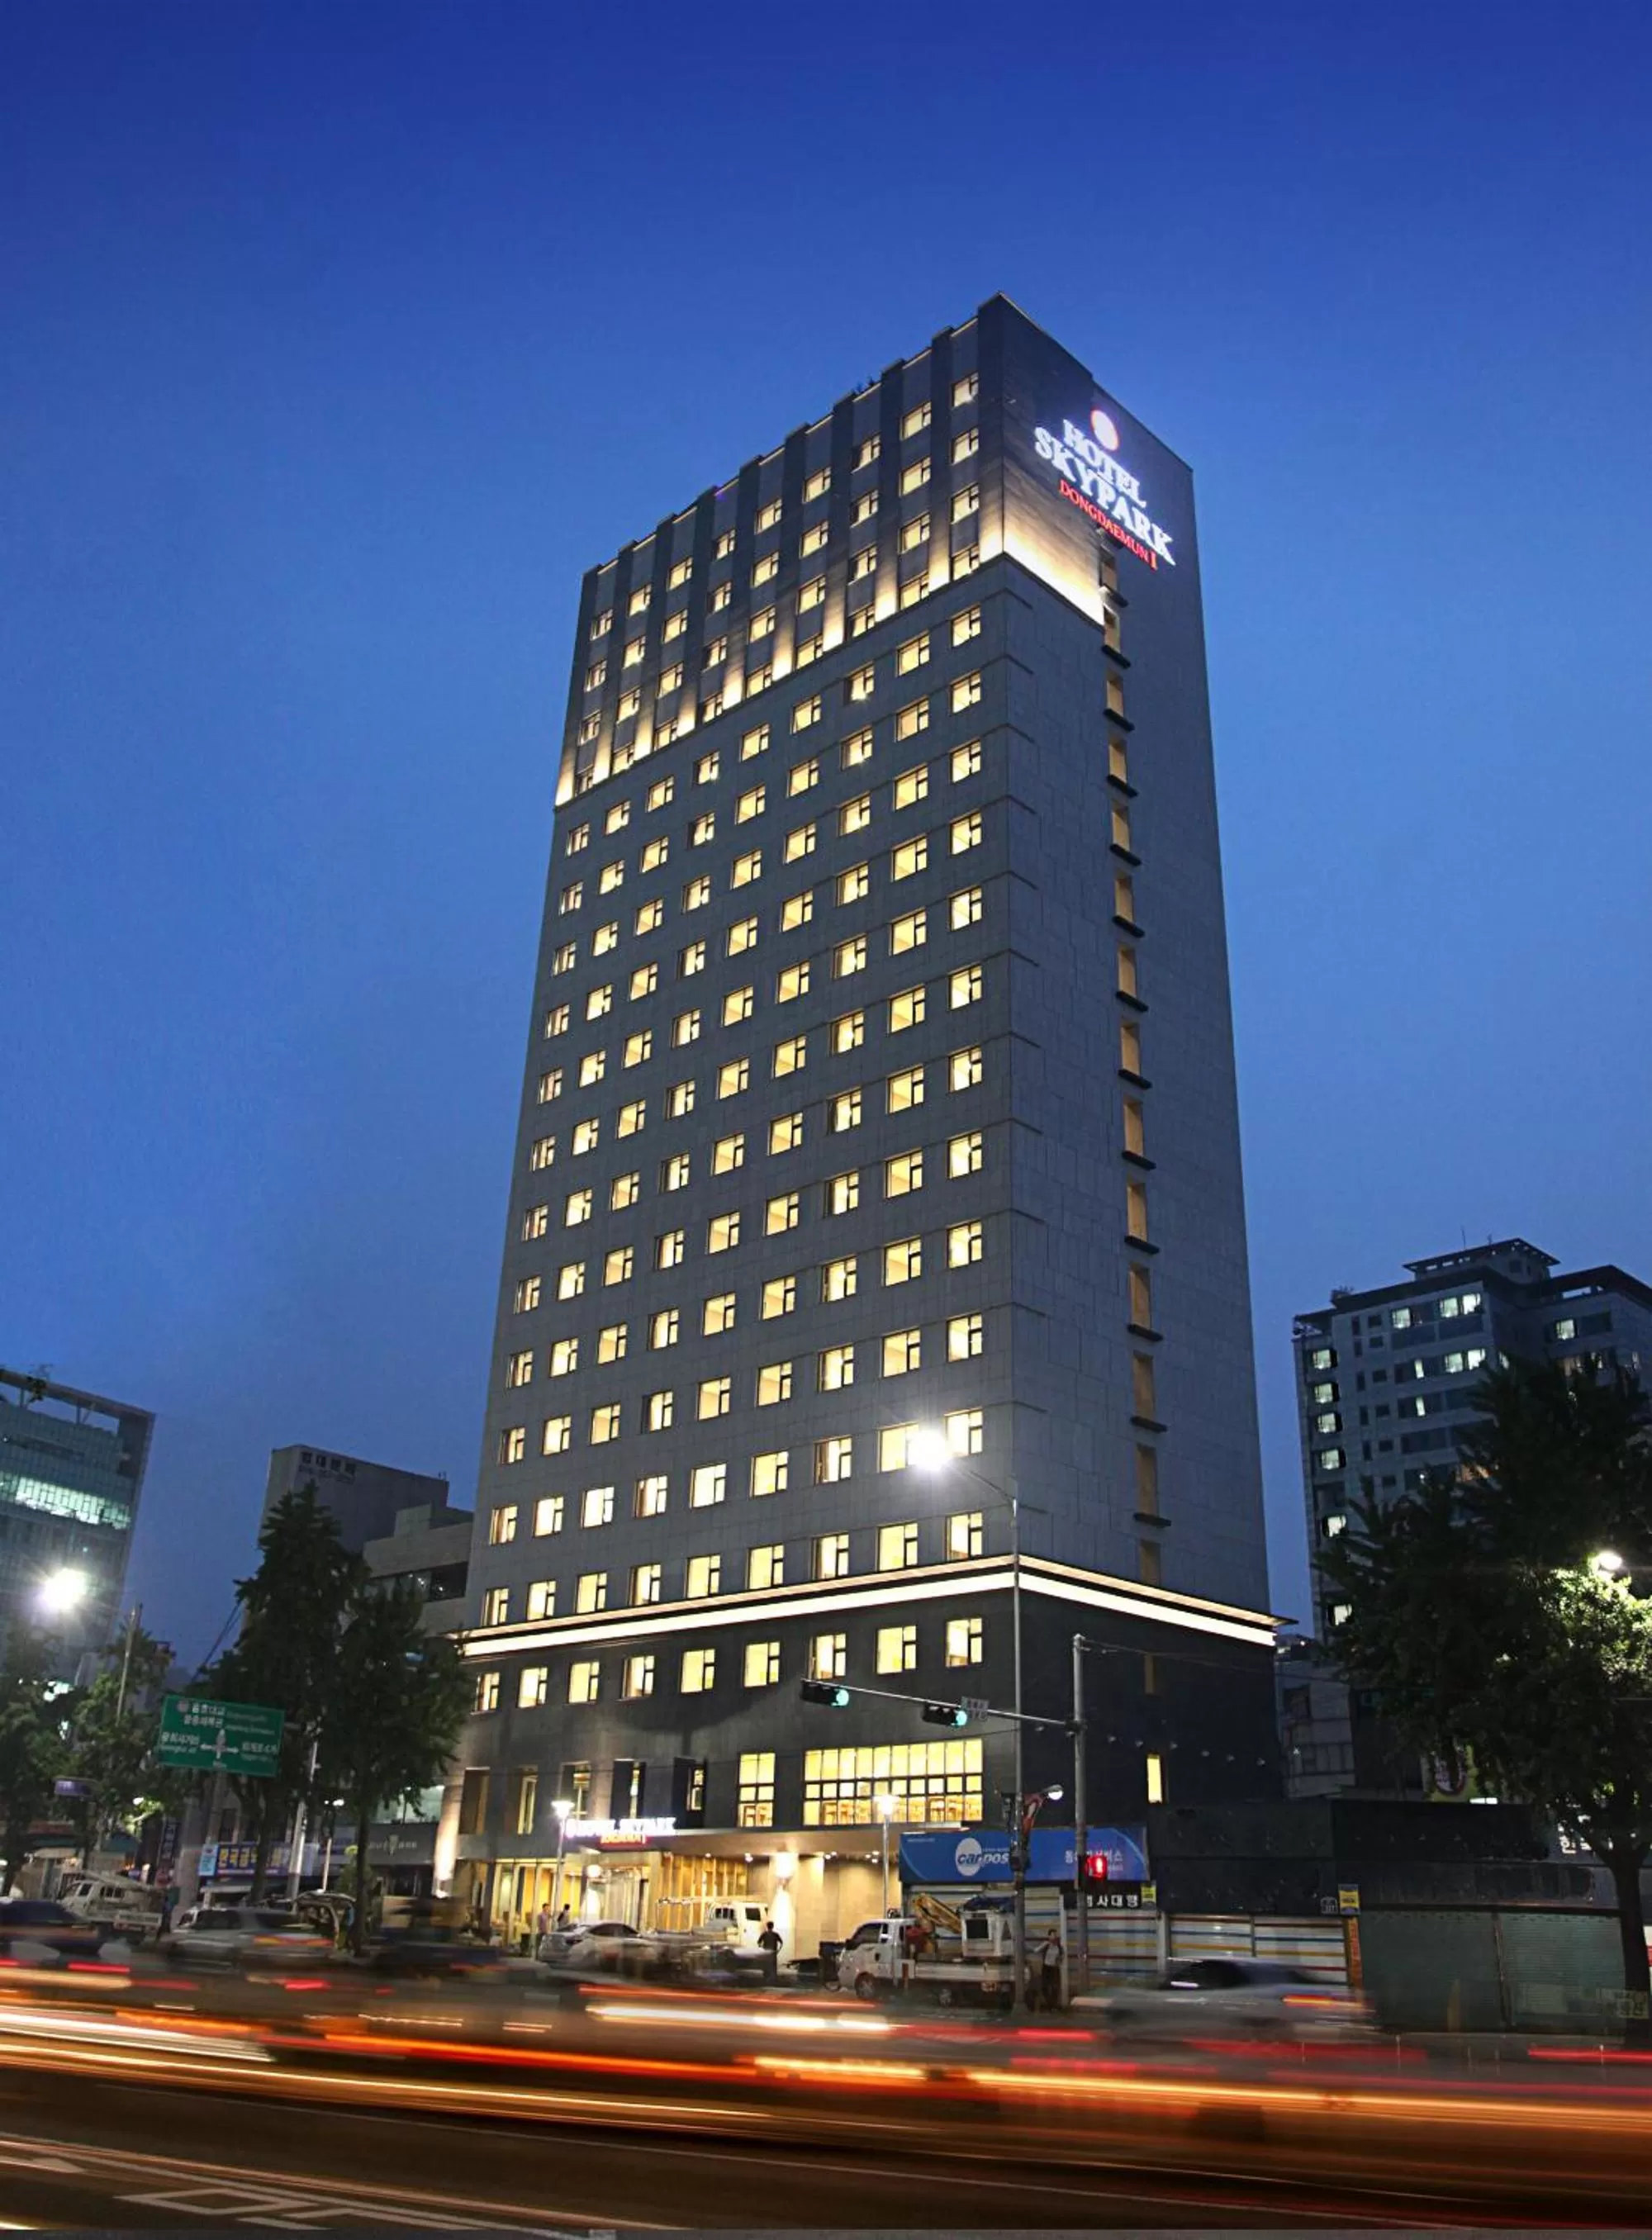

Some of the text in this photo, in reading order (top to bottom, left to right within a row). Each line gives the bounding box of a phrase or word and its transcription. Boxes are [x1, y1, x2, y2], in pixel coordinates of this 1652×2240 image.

[1034, 426, 1176, 567] SKYPARK
[1062, 419, 1147, 509] HOTEL
[1059, 478, 1149, 562] DONGDAEMUN
